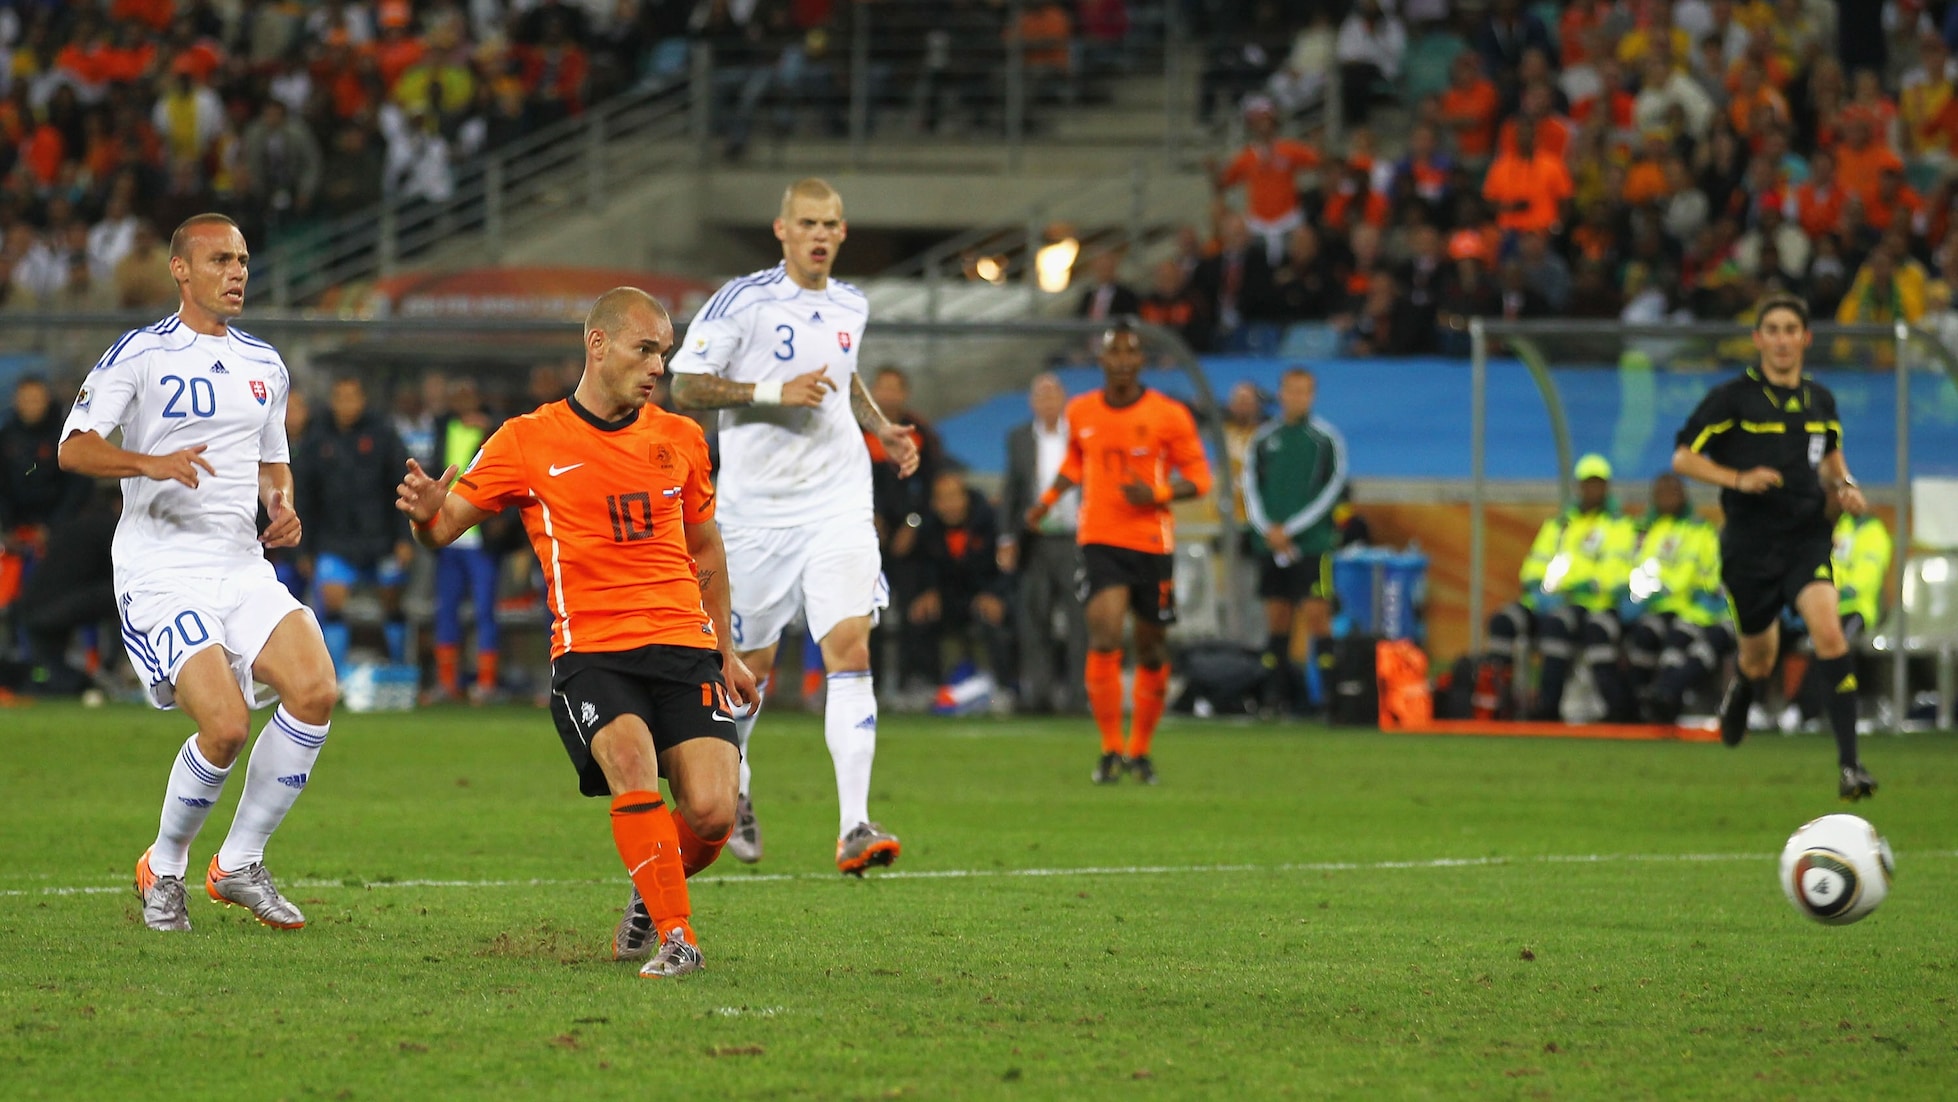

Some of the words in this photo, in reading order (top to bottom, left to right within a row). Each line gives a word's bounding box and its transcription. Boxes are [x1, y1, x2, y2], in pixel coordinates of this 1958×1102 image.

[774, 324, 794, 360] 3
[160, 375, 216, 418] 20
[606, 491, 654, 543] 10
[156, 610, 209, 669] 20
